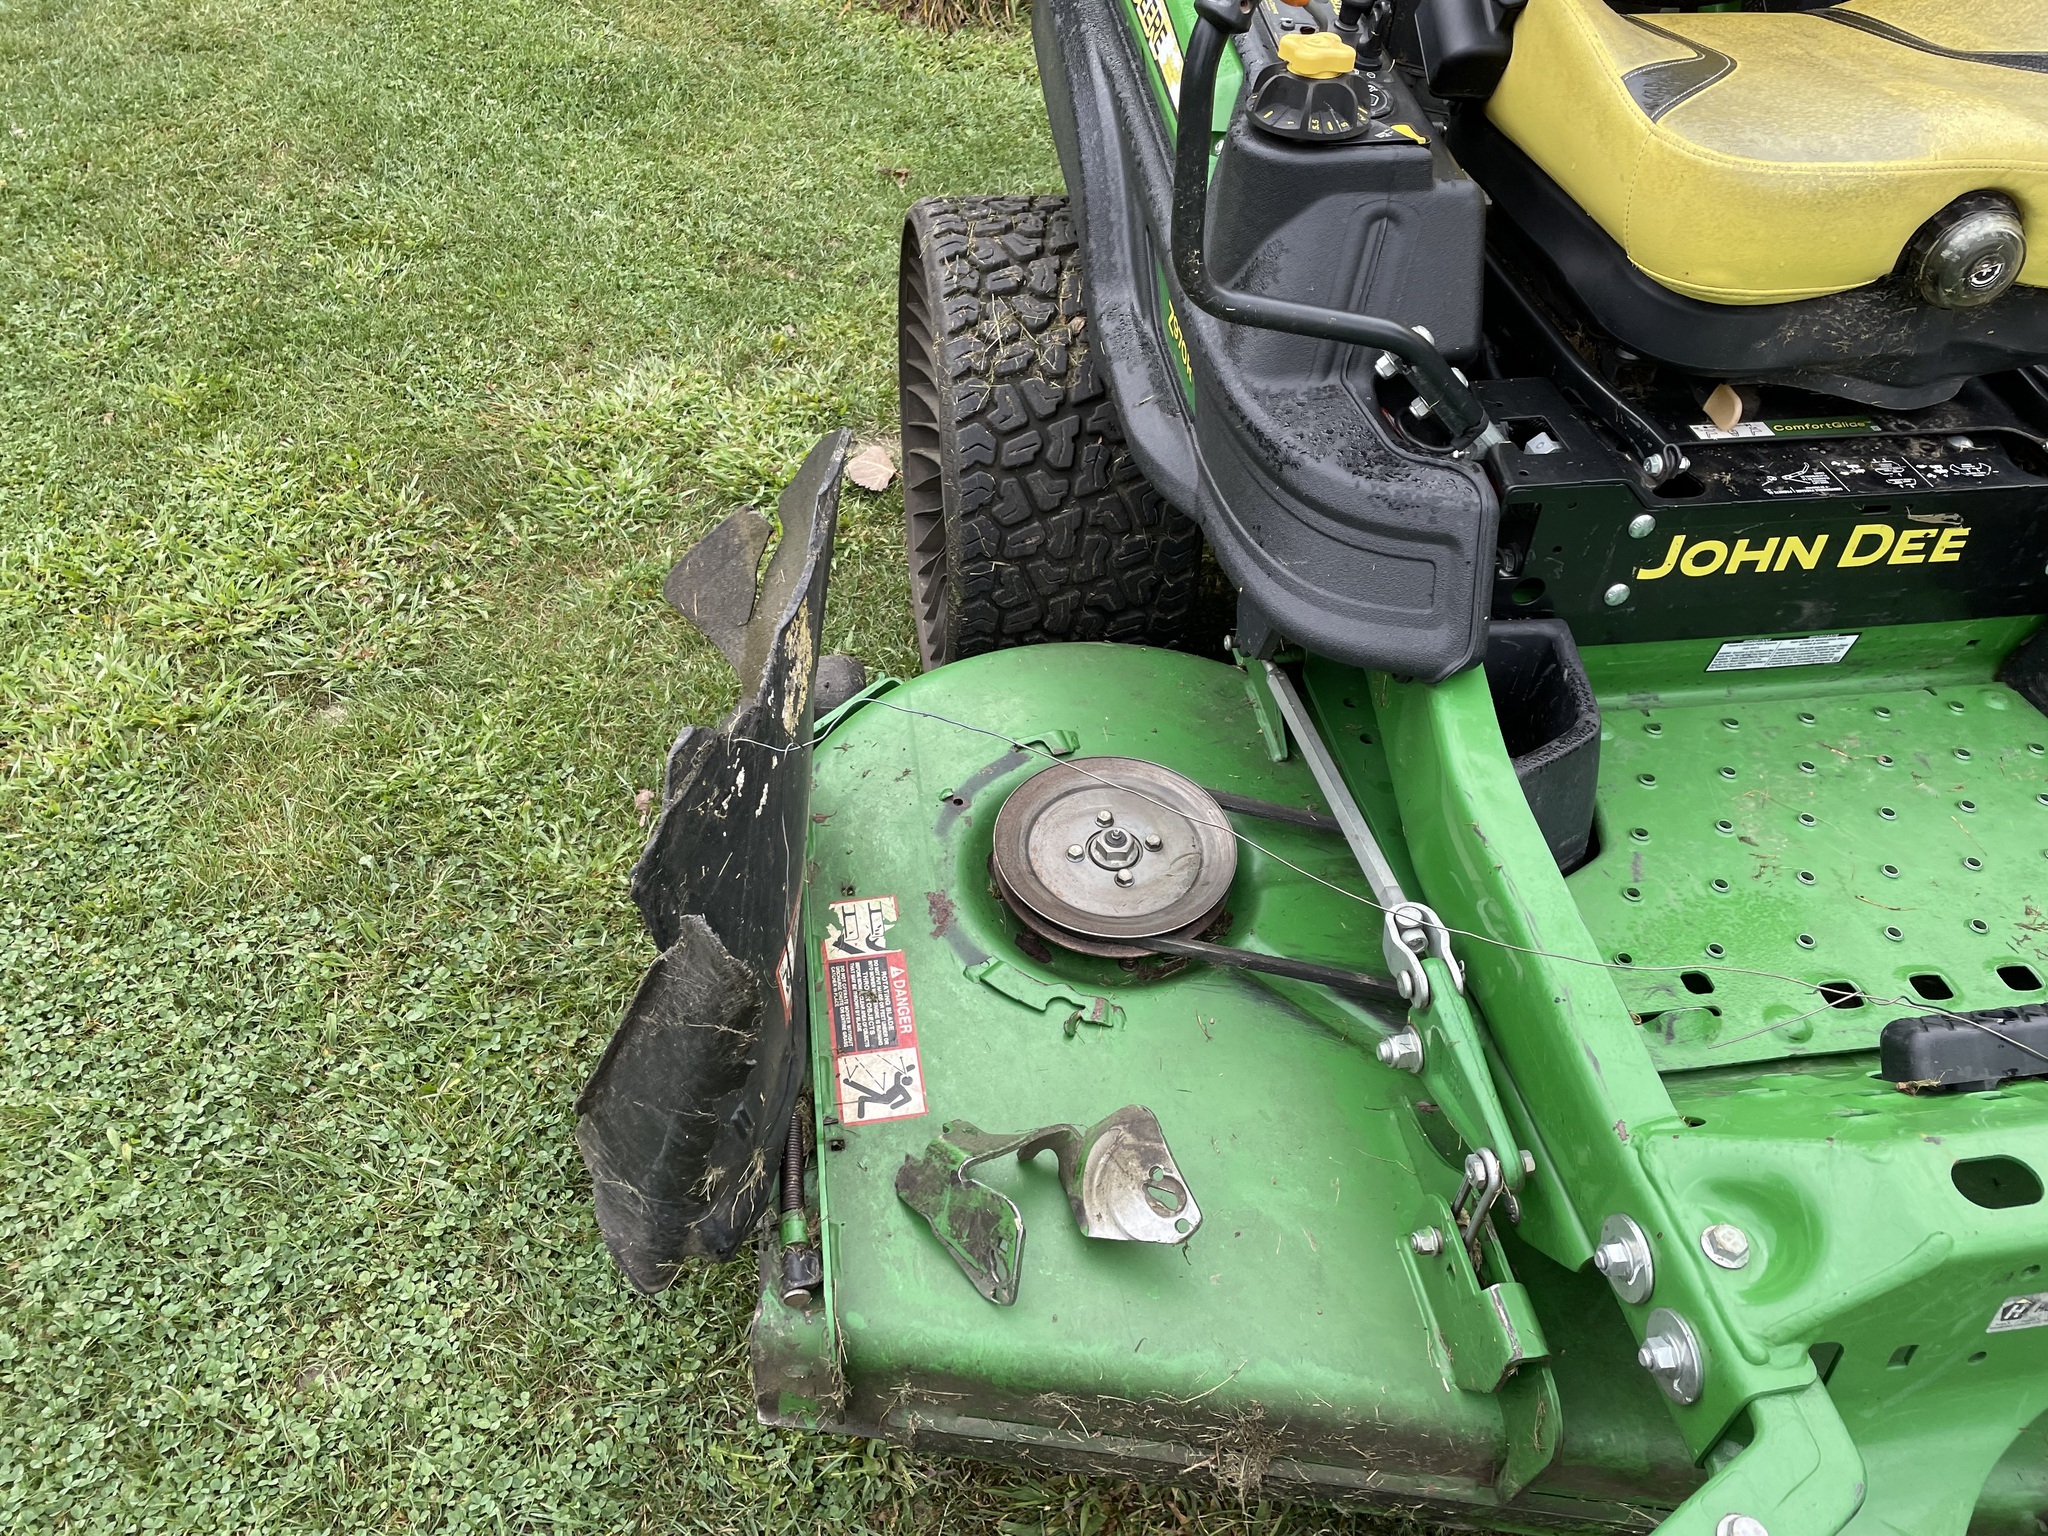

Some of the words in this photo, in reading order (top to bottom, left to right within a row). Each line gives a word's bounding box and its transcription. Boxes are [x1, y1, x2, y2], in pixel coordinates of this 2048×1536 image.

[1636, 534, 1829, 580] JOHN
[861, 971, 871, 1001] THRON
[880, 970, 891, 1005] ROTATING
[865, 1002, 875, 1035] OBJECTS
[885, 1006, 894, 1031] BLADE
[893, 978, 912, 1034] DANGER
[862, 1027, 870, 1047] OBJECTS
